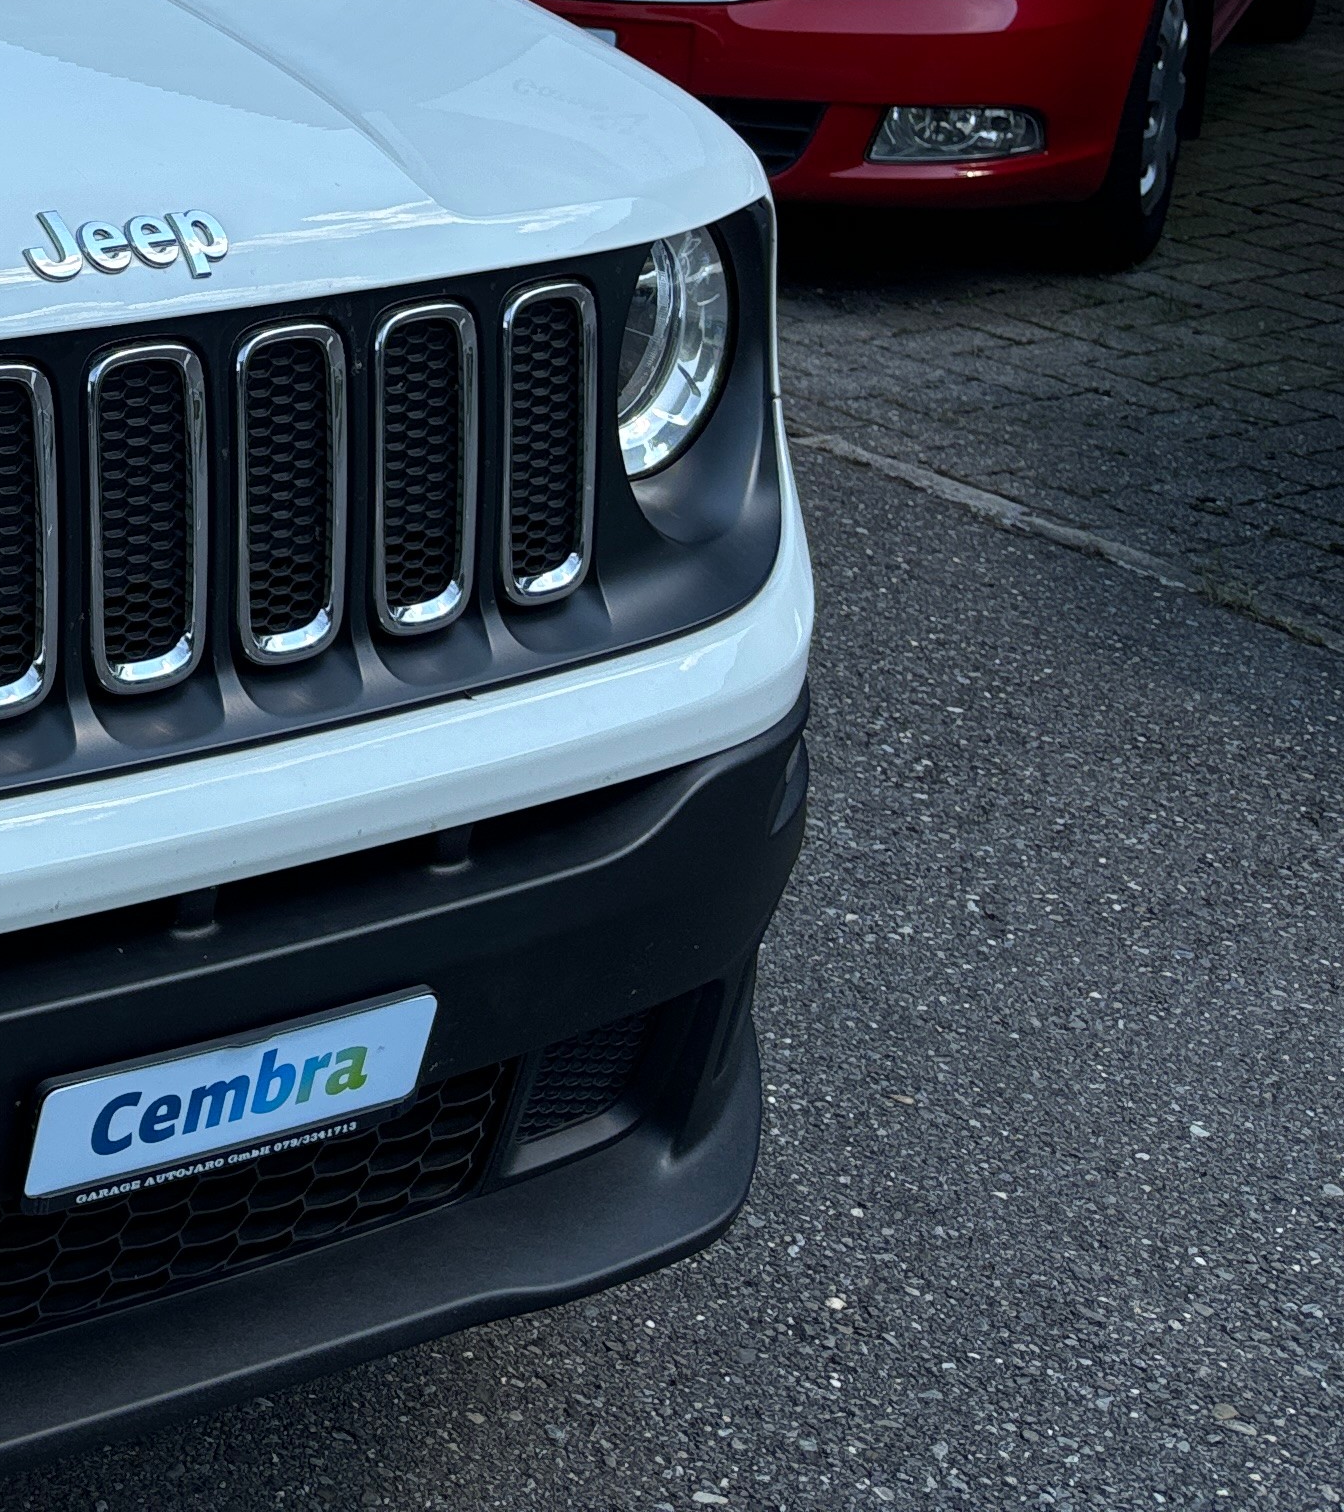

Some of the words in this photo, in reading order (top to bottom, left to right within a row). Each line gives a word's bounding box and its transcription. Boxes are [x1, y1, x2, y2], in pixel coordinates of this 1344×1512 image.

[22, 209, 229, 283] Jeep
[89, 1045, 369, 1157] Cembra
[75, 1180, 142, 1204] GARAGE
[144, 1157, 225, 1187] AUTOJARO
[227, 1144, 272, 1165] GmbH
